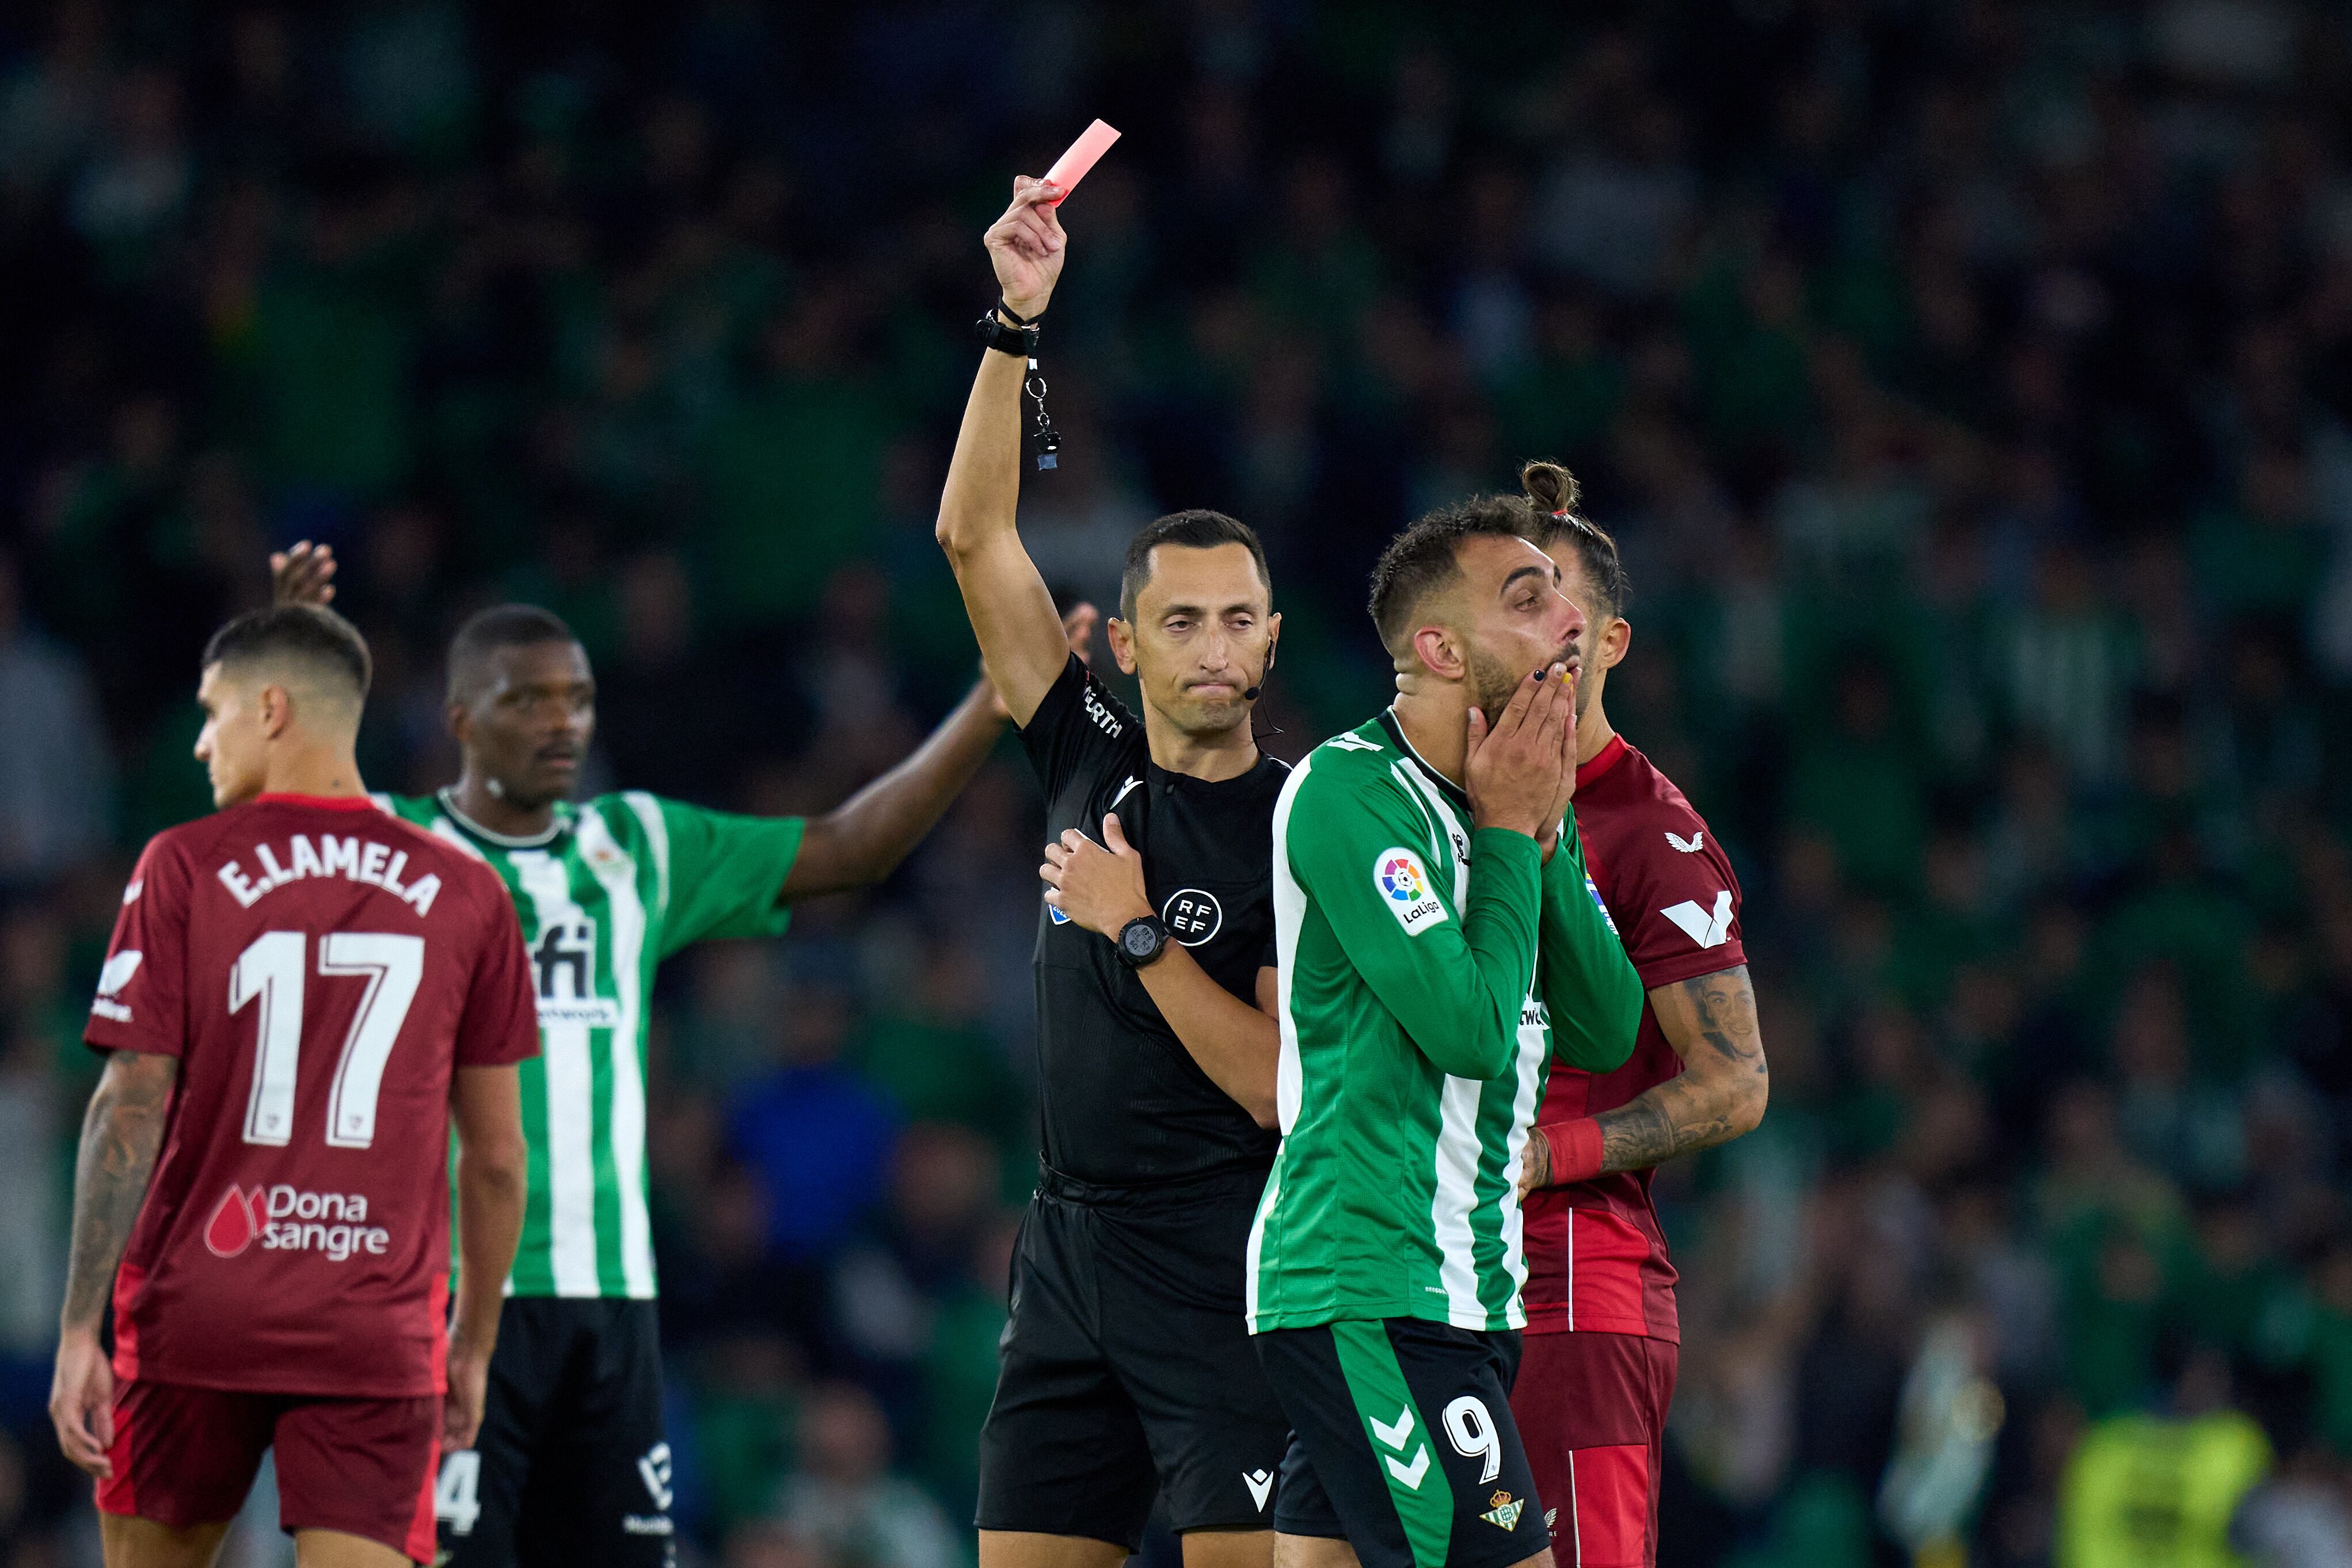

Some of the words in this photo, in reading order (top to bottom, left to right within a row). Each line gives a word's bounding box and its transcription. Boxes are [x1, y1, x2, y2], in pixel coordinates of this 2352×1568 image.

[218, 834, 442, 918] E.LAMELA
[1174, 915, 1206, 933] EF
[1178, 899, 1212, 916] RF
[1403, 901, 1440, 924] LaLiga
[229, 931, 425, 1149] 17
[267, 1184, 368, 1220] Dona
[262, 1221, 390, 1261] sangre
[1441, 1395, 1501, 1485] 9
